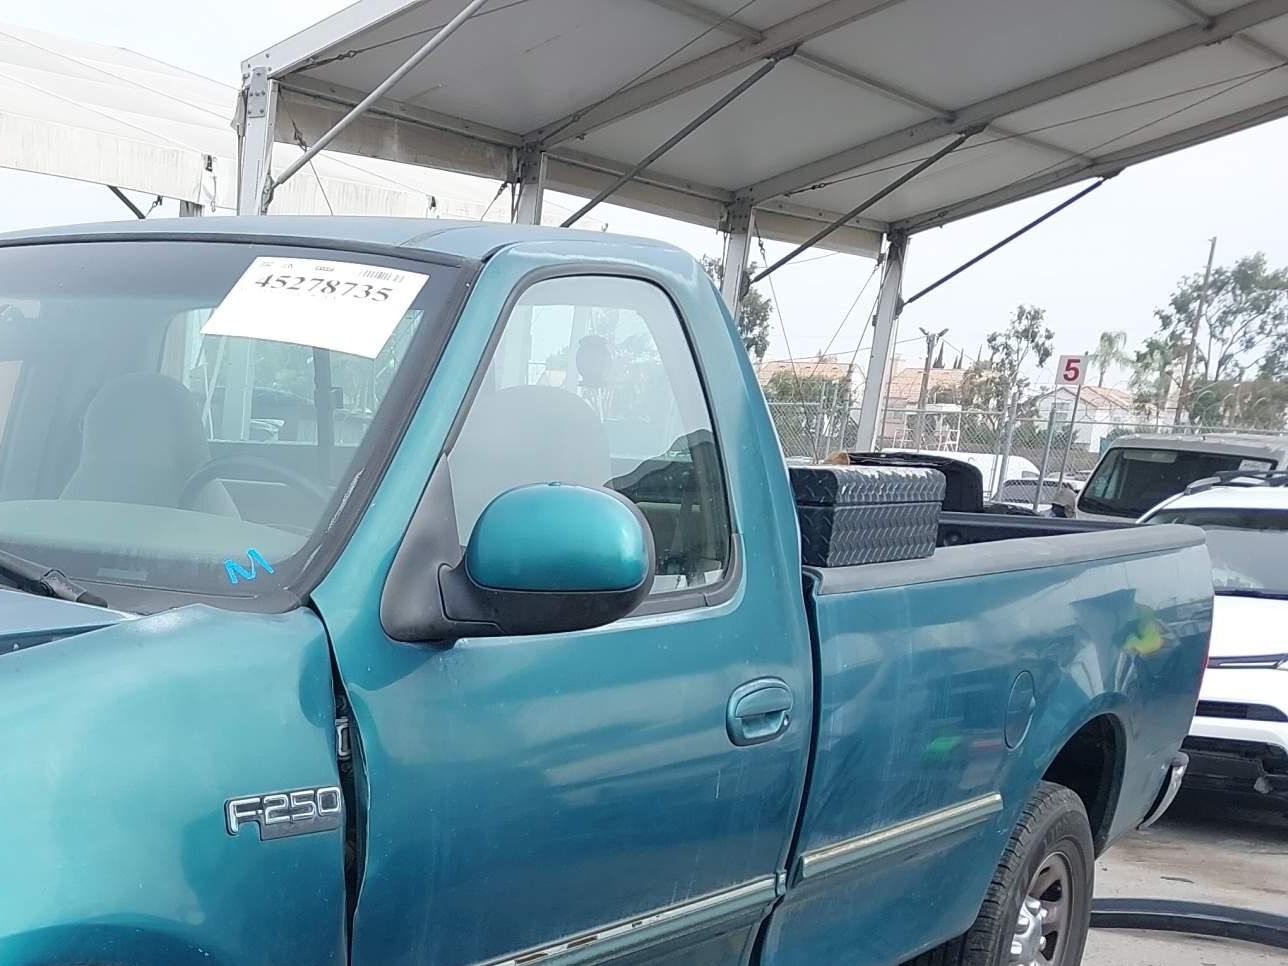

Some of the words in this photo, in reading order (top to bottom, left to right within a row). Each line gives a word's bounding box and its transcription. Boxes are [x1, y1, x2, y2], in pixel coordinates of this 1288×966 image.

[255, 274, 393, 302] 45278735
[1063, 359, 1080, 381] 5
[224, 548, 274, 584] M
